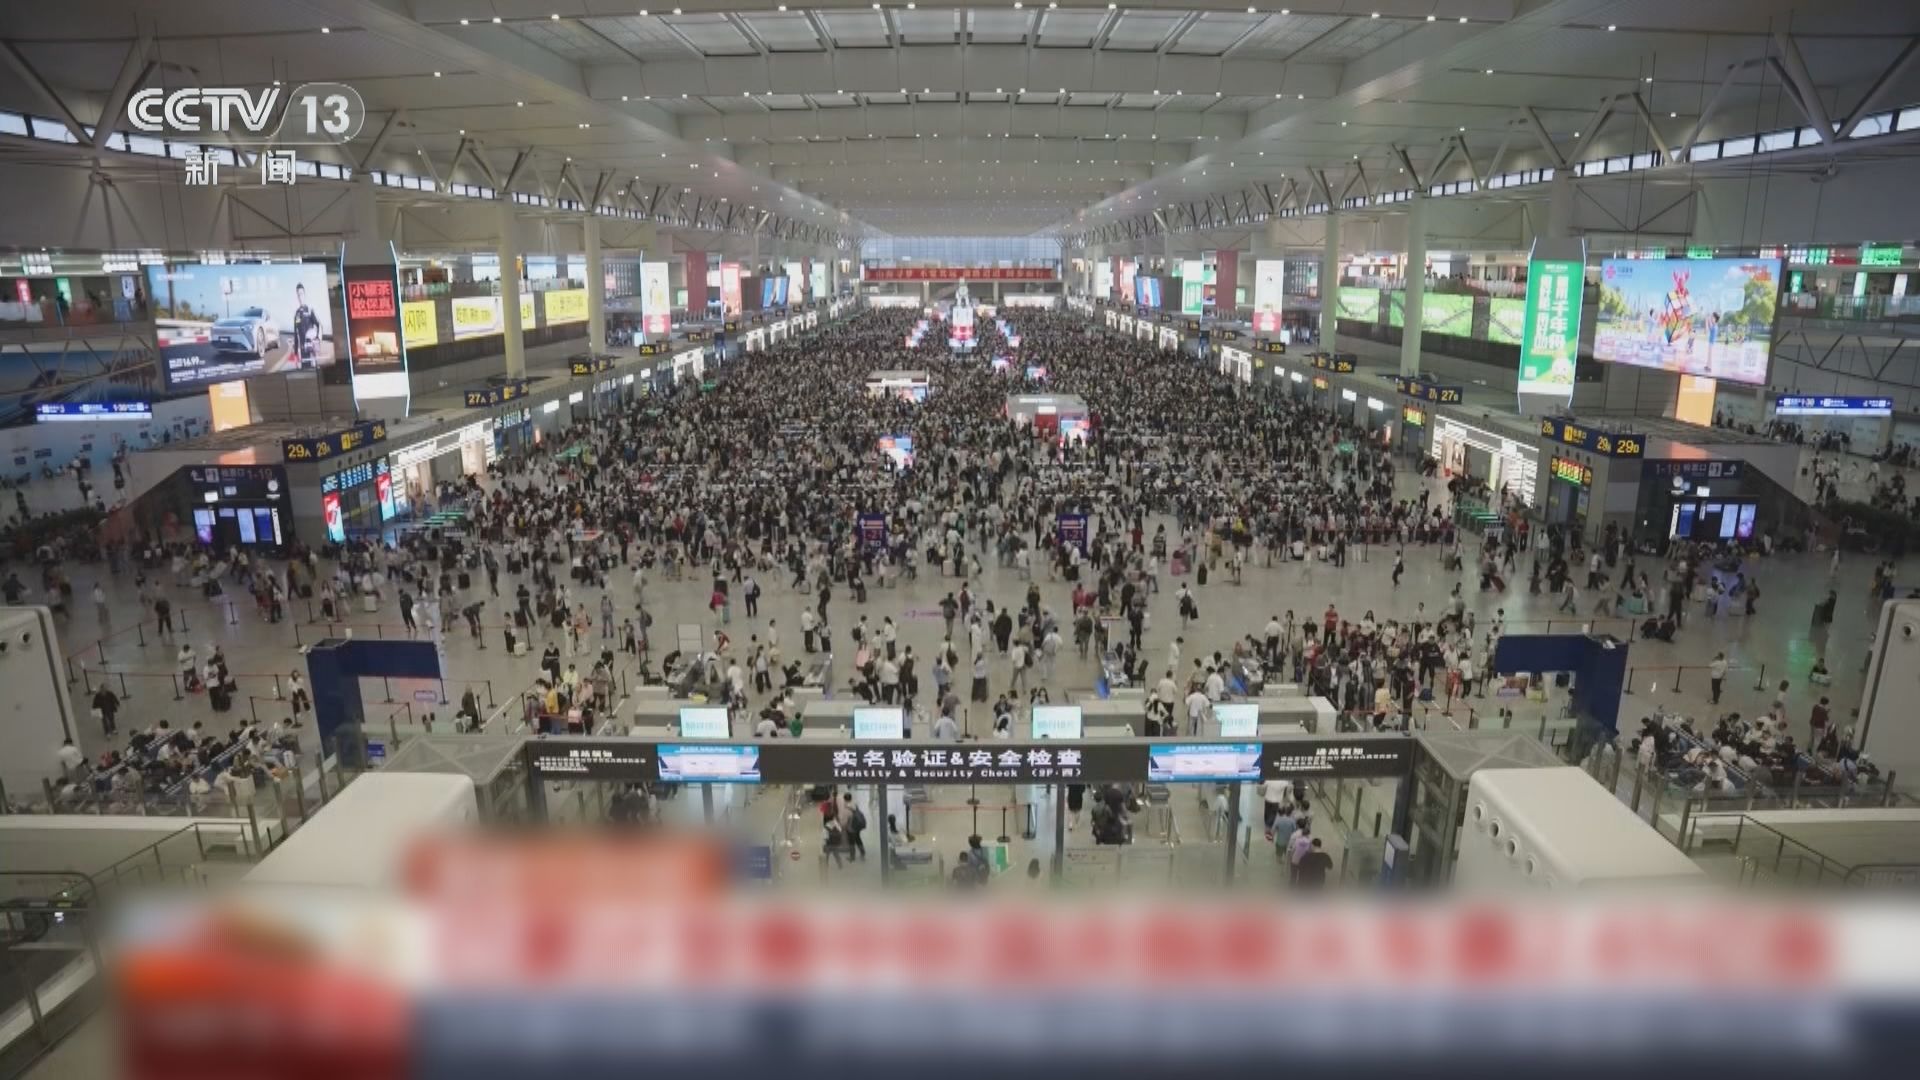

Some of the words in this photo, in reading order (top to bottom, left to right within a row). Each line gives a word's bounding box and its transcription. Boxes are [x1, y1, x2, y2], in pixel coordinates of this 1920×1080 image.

[468, 394, 486, 405] 27A
[288, 444, 311, 458] 29A
[833, 749, 1082, 767] 实名验证&安全检查
[833, 768, 891, 778] Identity
[915, 768, 973, 778] Security
[981, 768, 1017, 777] Check
